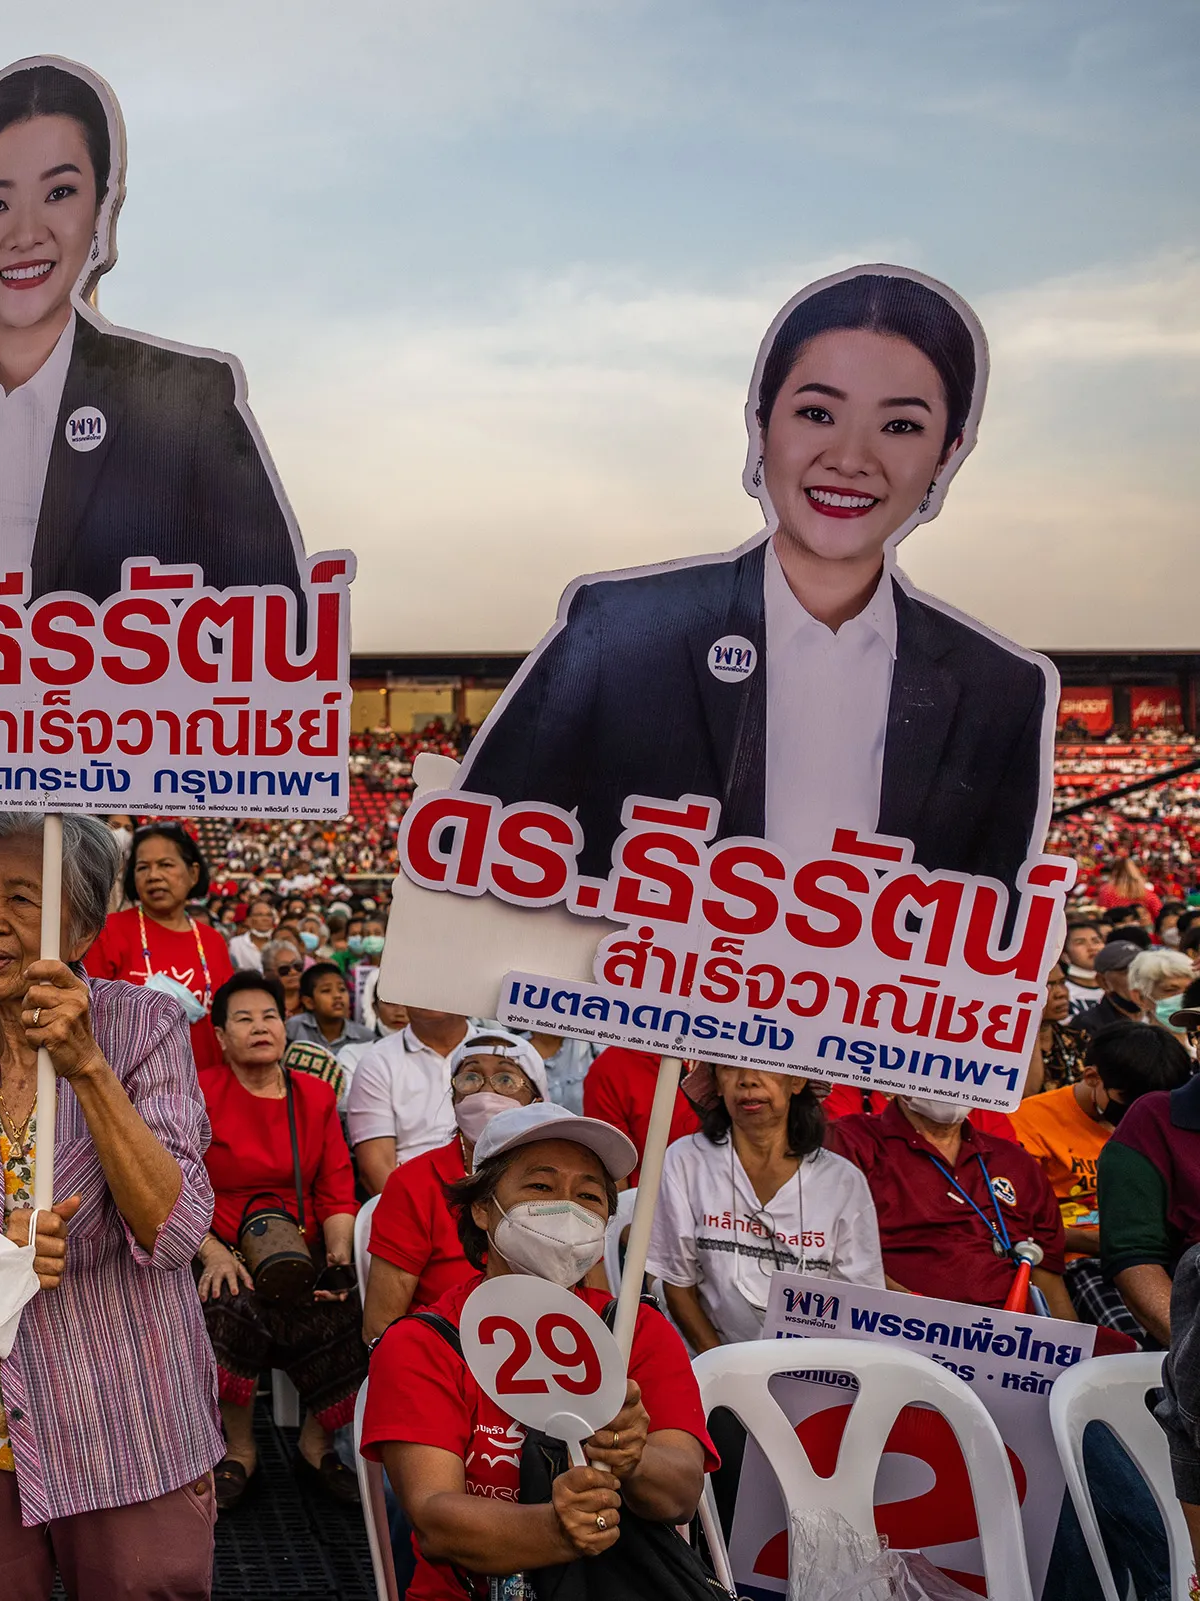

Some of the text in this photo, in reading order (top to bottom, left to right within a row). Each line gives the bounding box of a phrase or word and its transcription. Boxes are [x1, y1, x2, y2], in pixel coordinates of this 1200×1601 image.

[69, 417, 101, 436] พท
[714, 645, 752, 667] พท
[153, 768, 341, 803] กรุงเทพฯ
[406, 798, 1067, 983] ดร.ธีรรัตน์
[602, 925, 1038, 1054] สำเร็จวาณิชย์
[508, 979, 1019, 1091] เขตลาดกระบัง กรุงเทพฯ
[852, 1074, 871, 1083] 10160
[993, 1099, 1010, 1107] 2566
[782, 1287, 840, 1320] พท
[784, 1313, 837, 1331] พรรคเพื่อไทย
[850, 1307, 1082, 1368] พรรคเพื่อไทย
[478, 1312, 602, 1395] 29
[1001, 1371, 1054, 1396] หลัก
[504, 1586, 524, 1597] Pure
